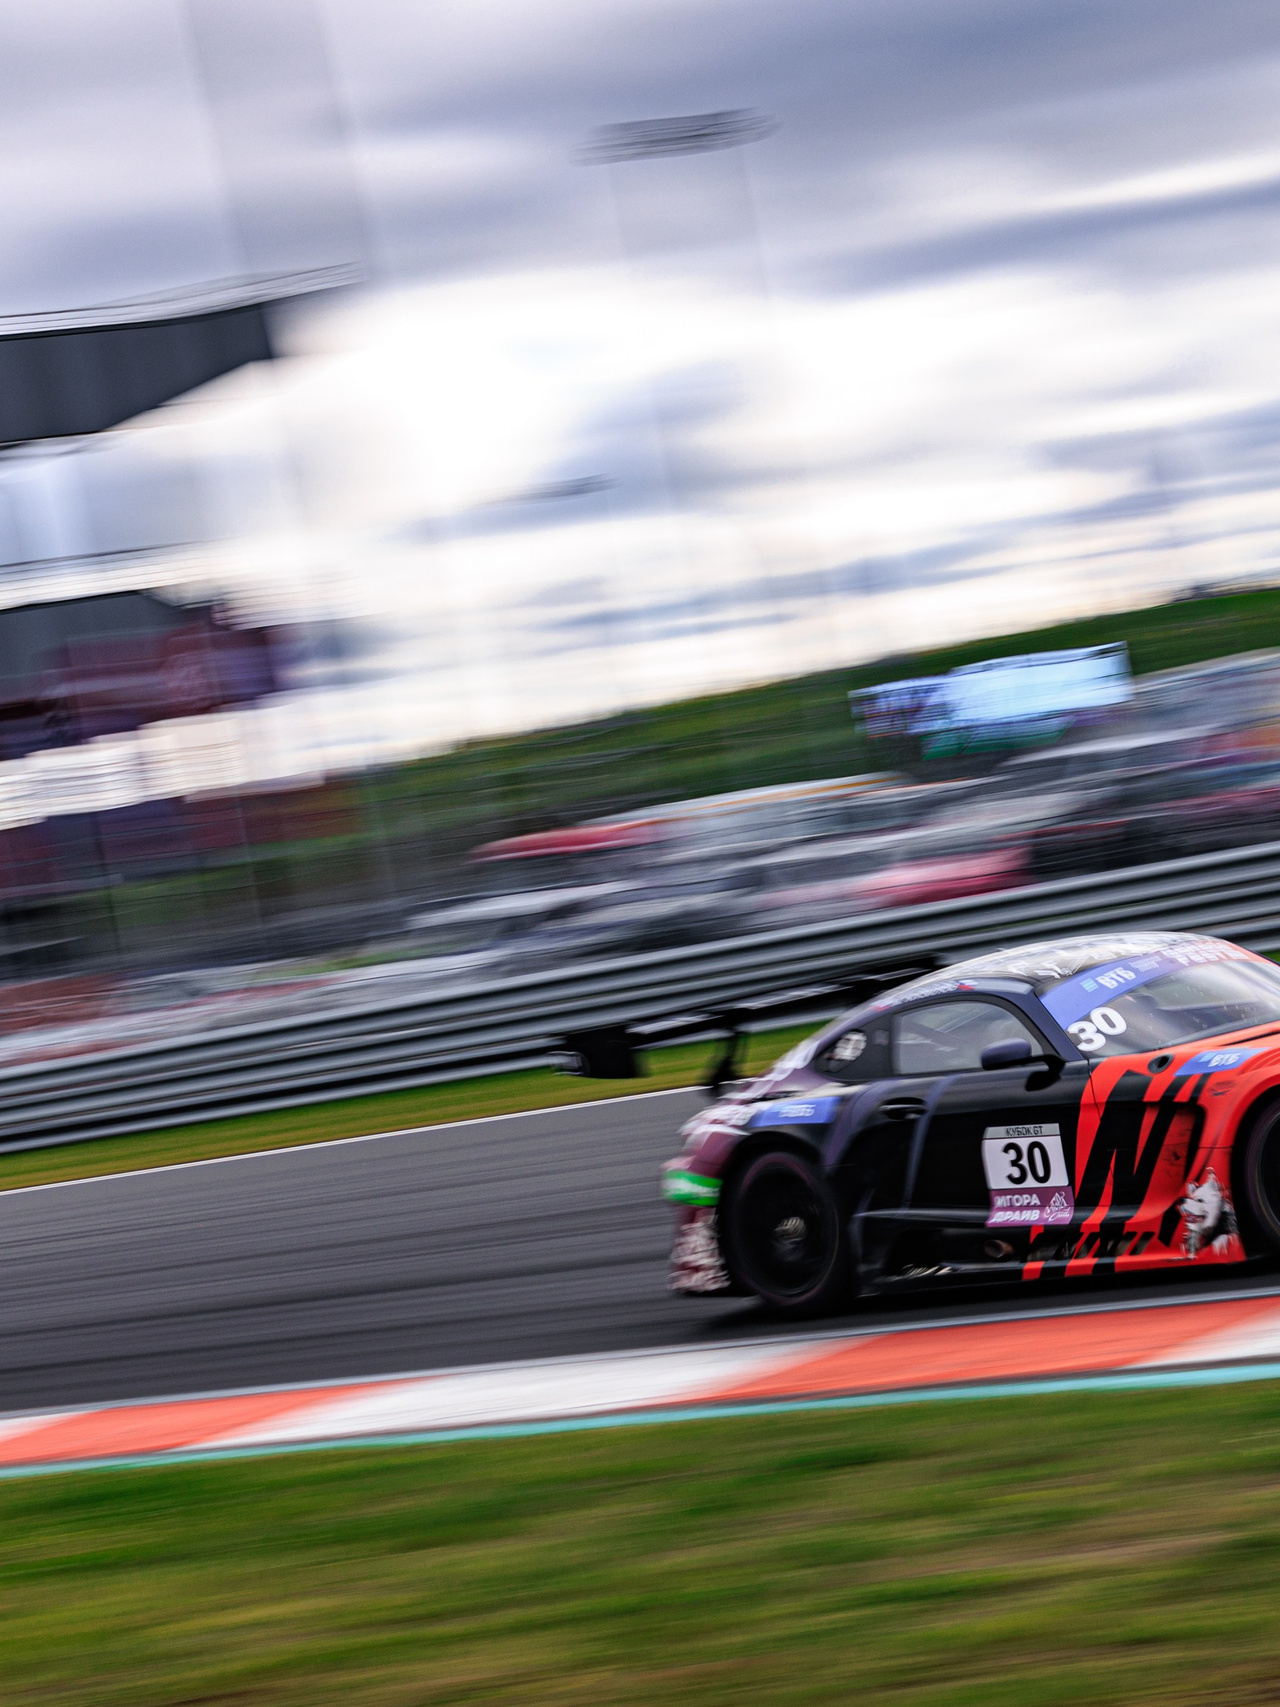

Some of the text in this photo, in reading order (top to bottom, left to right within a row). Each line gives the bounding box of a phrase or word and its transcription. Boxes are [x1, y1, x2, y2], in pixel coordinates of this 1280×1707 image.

[1095, 967, 1136, 989] ВТБ
[1067, 1006, 1127, 1051] 30
[1208, 1053, 1242, 1067] ВТБ
[1005, 1126, 1043, 1137] КУБОК GT
[1002, 1141, 1051, 1185] 30
[995, 1194, 1040, 1207] ИГОРА
